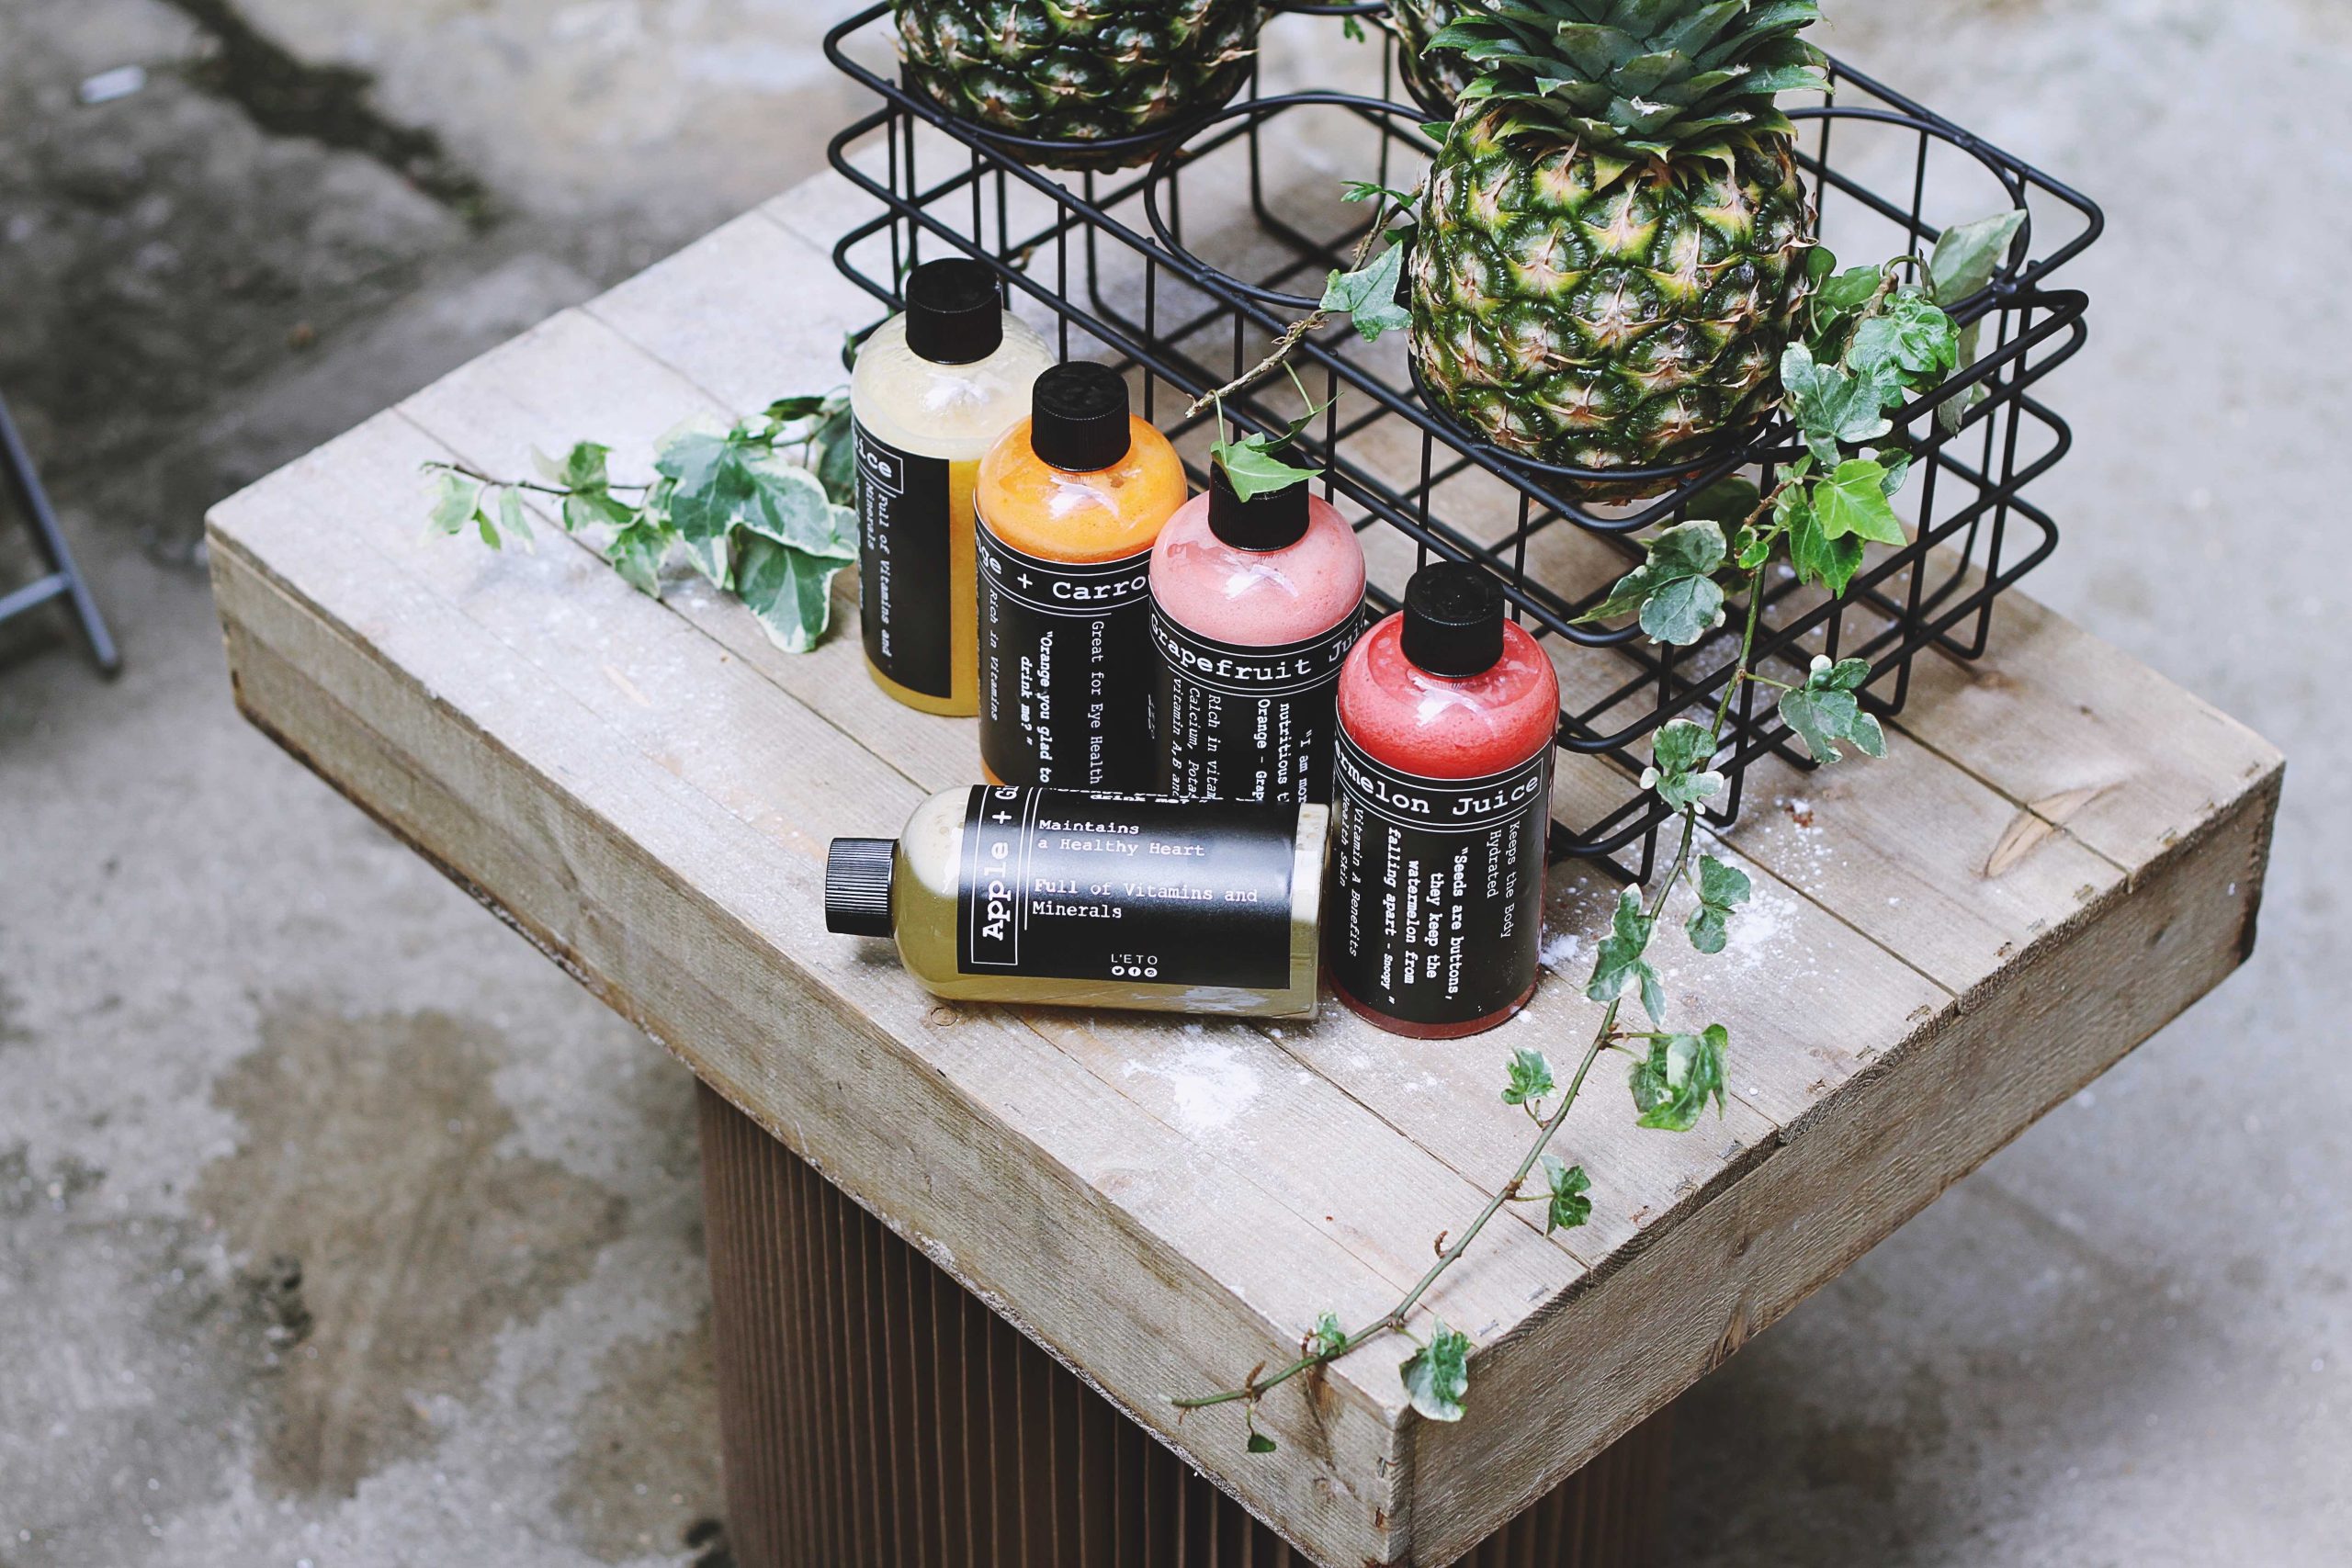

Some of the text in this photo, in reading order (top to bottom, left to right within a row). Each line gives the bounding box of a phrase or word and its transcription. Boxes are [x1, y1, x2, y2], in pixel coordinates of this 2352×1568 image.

[865, 481, 876, 550] Minerals
[878, 493, 892, 657] Full of Vitamins and
[1017, 573, 1034, 589] +
[1052, 576, 1147, 600] Carro
[989, 588, 1000, 721] Rich in Vitamins
[1021, 656, 1033, 699] drink
[1151, 613, 1312, 680] Grapefruit
[1035, 631, 1053, 784] "Orange you glad to
[1088, 621, 1104, 784] Great for Eye Health
[1172, 679, 1183, 735] vitamin
[1187, 688, 1202, 750] Calcium,
[1207, 694, 1222, 728] Rich
[1254, 699, 1272, 749] Orange
[1207, 736, 1221, 751] in
[1277, 703, 1292, 784] nutritious
[1299, 755, 1309, 773] am
[1335, 739, 1430, 814] ermelon
[1452, 776, 1539, 816] Juice
[992, 811, 1012, 824] +
[1038, 820, 1139, 835] Maintains
[1038, 839, 1205, 857] a Healthy Heart
[1340, 793, 1351, 887] Health Skin
[1349, 808, 1364, 957] Vitamin A Benefits
[1384, 827, 1402, 887] falling
[1487, 829, 1502, 899] Hydrated
[1500, 820, 1521, 938] Keeps the Body
[983, 841, 1012, 942] Apple
[1032, 901, 1122, 919] Minerals
[1035, 878, 1258, 903] Full of Vitamins and
[1383, 894, 1397, 936] apart
[1404, 861, 1420, 985] watermelon from
[1424, 873, 1444, 978] they keep the
[1444, 847, 1469, 1000] "Seeds are buttons,
[1381, 953, 1394, 990] Snoopy
